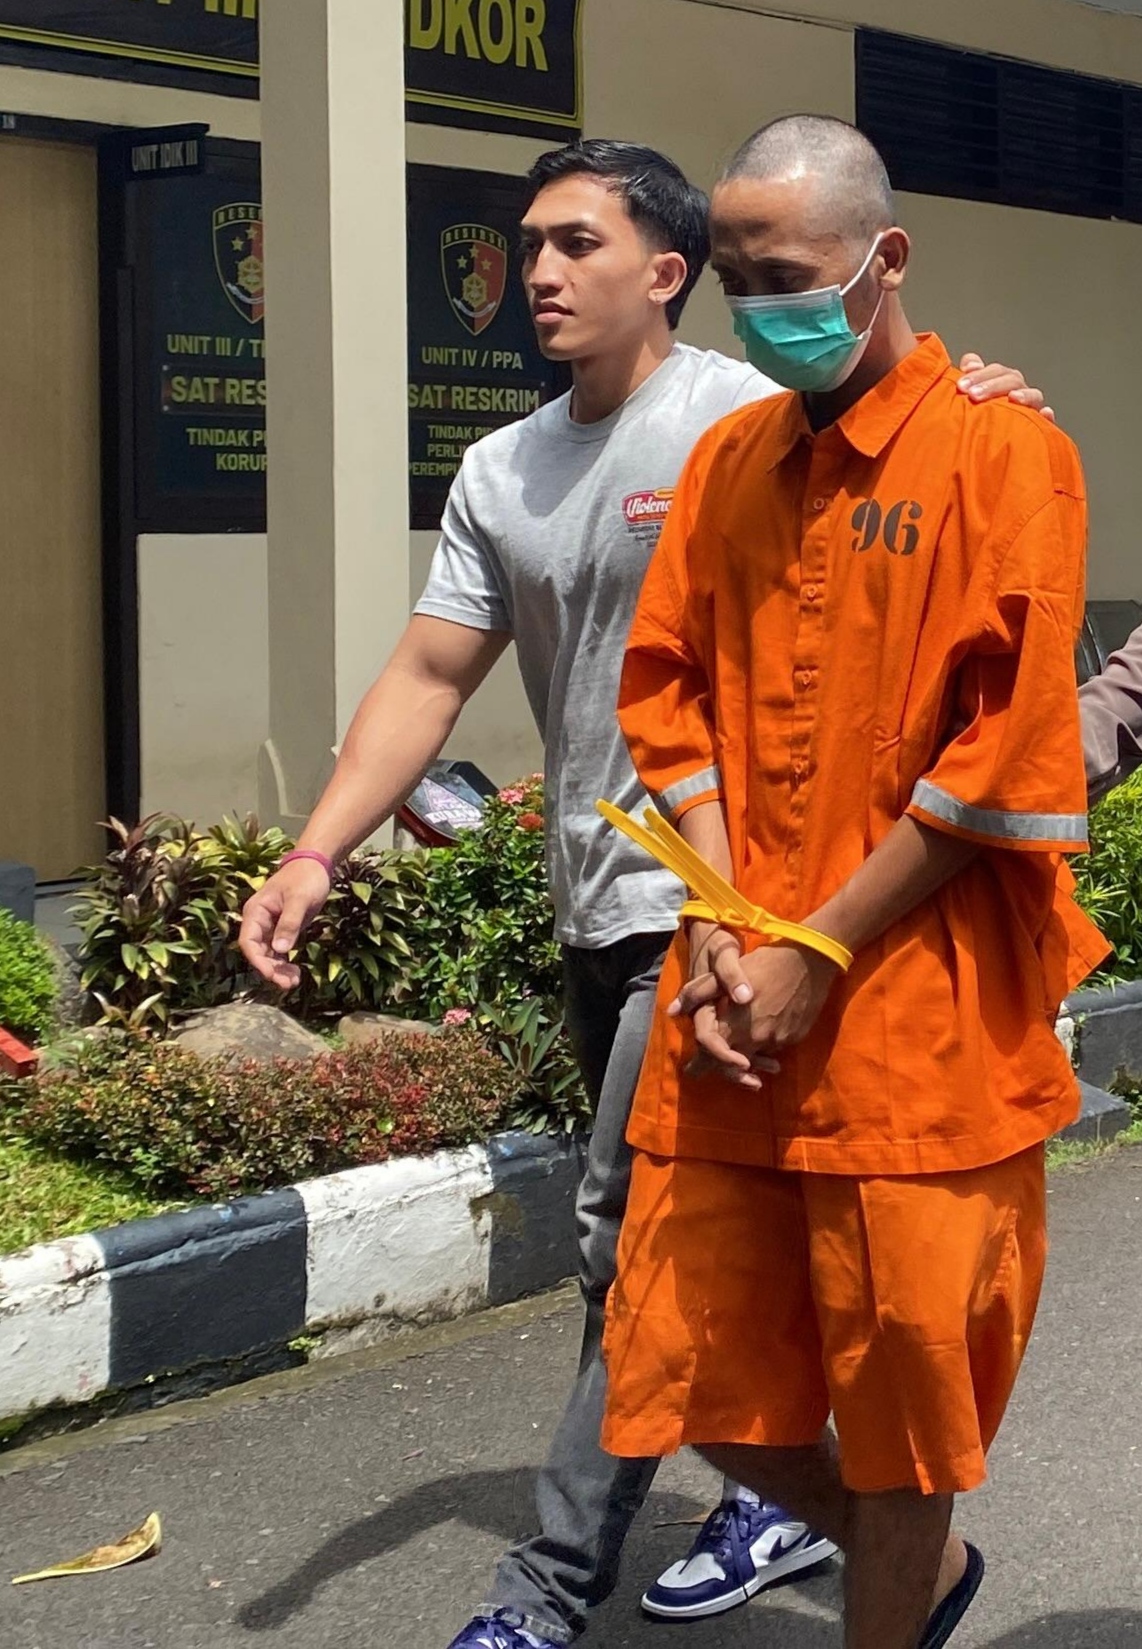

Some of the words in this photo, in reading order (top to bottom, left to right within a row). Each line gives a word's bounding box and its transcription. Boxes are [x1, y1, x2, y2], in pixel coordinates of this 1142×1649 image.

[167, 334, 212, 355] UNIT
[215, 337, 232, 356] III
[235, 338, 244, 357] /
[422, 346, 459, 366] UNIT
[462, 349, 478, 367] IV
[481, 350, 489, 368] /
[492, 351, 524, 370] PPA
[170, 376, 220, 404] SAT
[224, 378, 267, 406] RES
[408, 383, 447, 409] SAT
[451, 386, 540, 413] RESKRIM
[186, 428, 250, 447] TINDAK
[427, 425, 473, 439] TINDAK
[851, 498, 923, 555] 96
